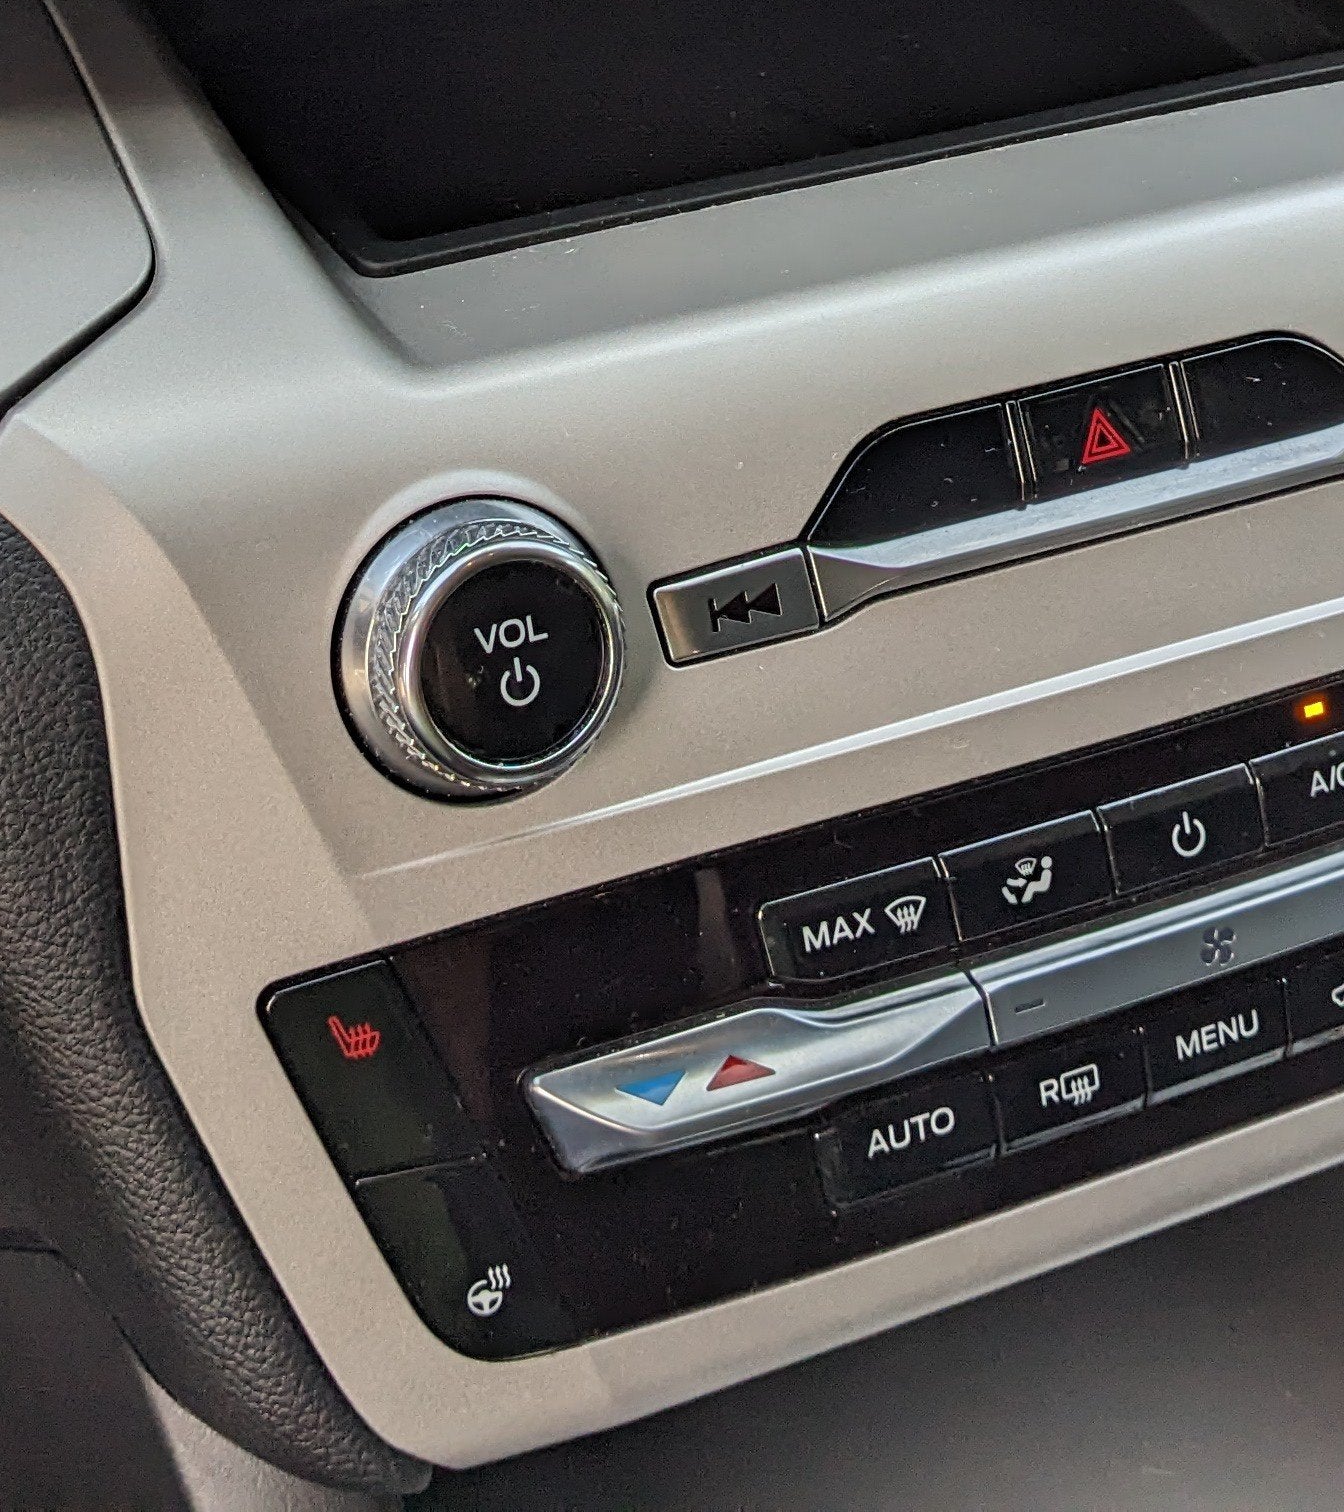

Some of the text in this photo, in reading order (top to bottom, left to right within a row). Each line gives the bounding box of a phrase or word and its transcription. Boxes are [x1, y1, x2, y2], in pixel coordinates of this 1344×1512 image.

[474, 614, 549, 655] VOL
[801, 908, 876, 953] MAX
[1174, 1009, 1260, 1062] MENU
[867, 1105, 956, 1159] AUTO
